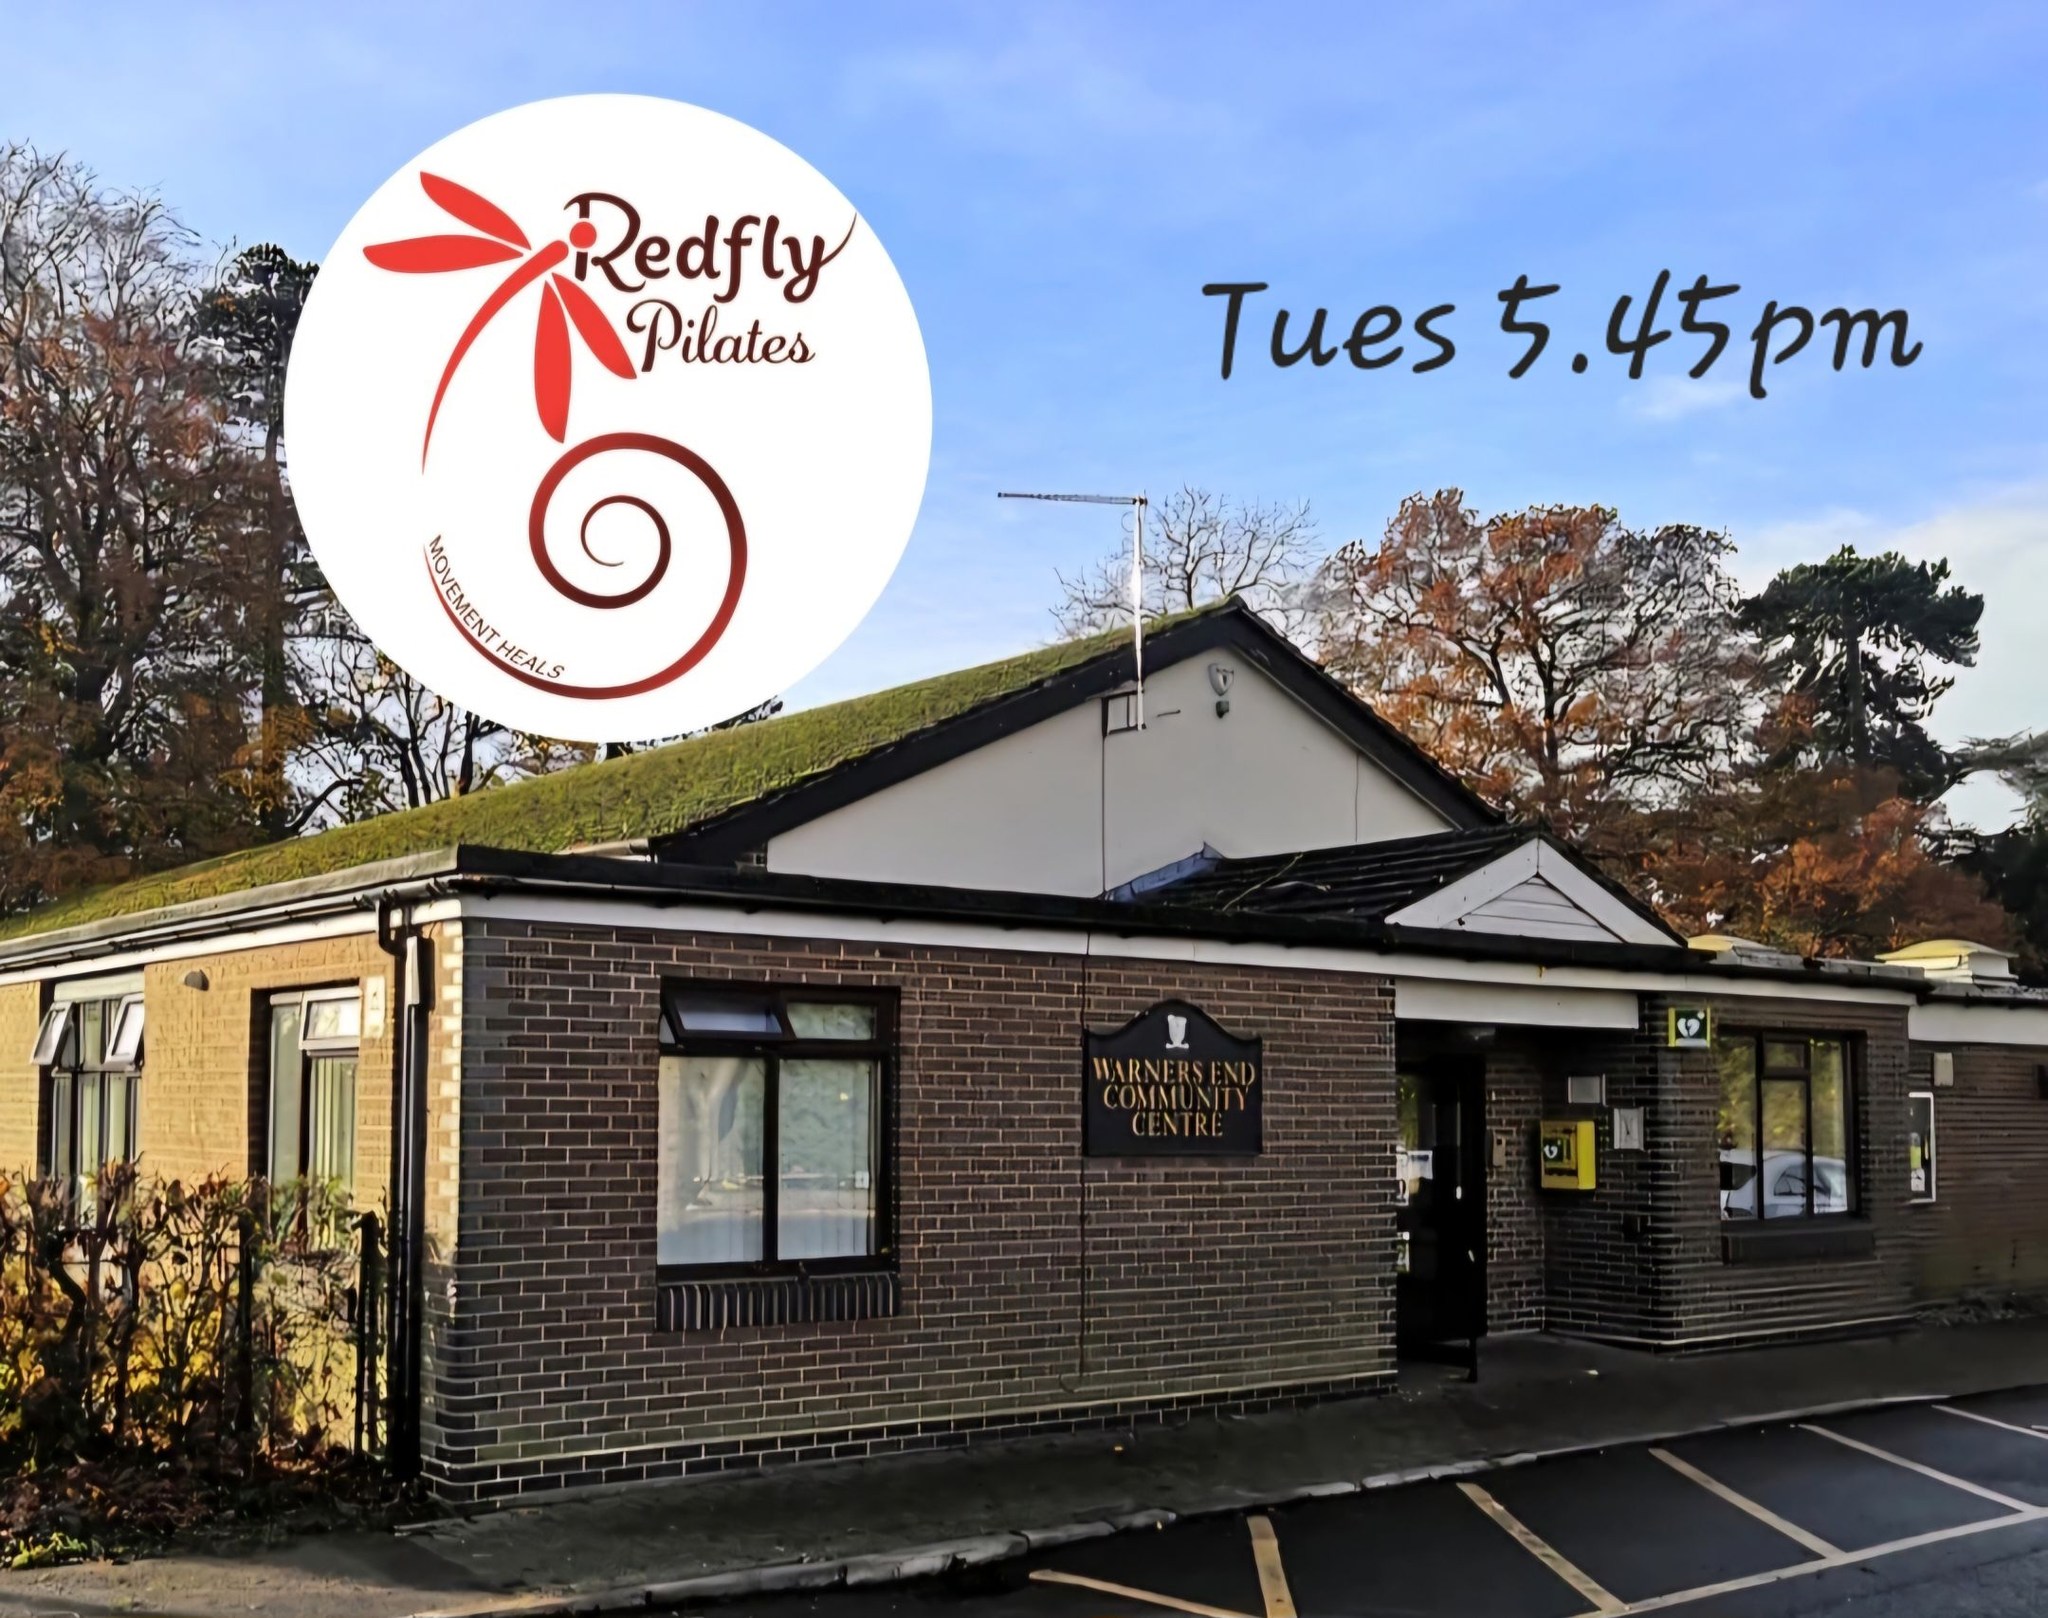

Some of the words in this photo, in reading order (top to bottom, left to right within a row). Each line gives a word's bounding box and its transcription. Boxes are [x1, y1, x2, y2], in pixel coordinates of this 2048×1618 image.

[1093, 1057, 1203, 1084] WARNERS
[1211, 1060, 1256, 1086] END
[1103, 1084, 1250, 1111] COMMUNITY
[1132, 1111, 1224, 1137] CENTRE
